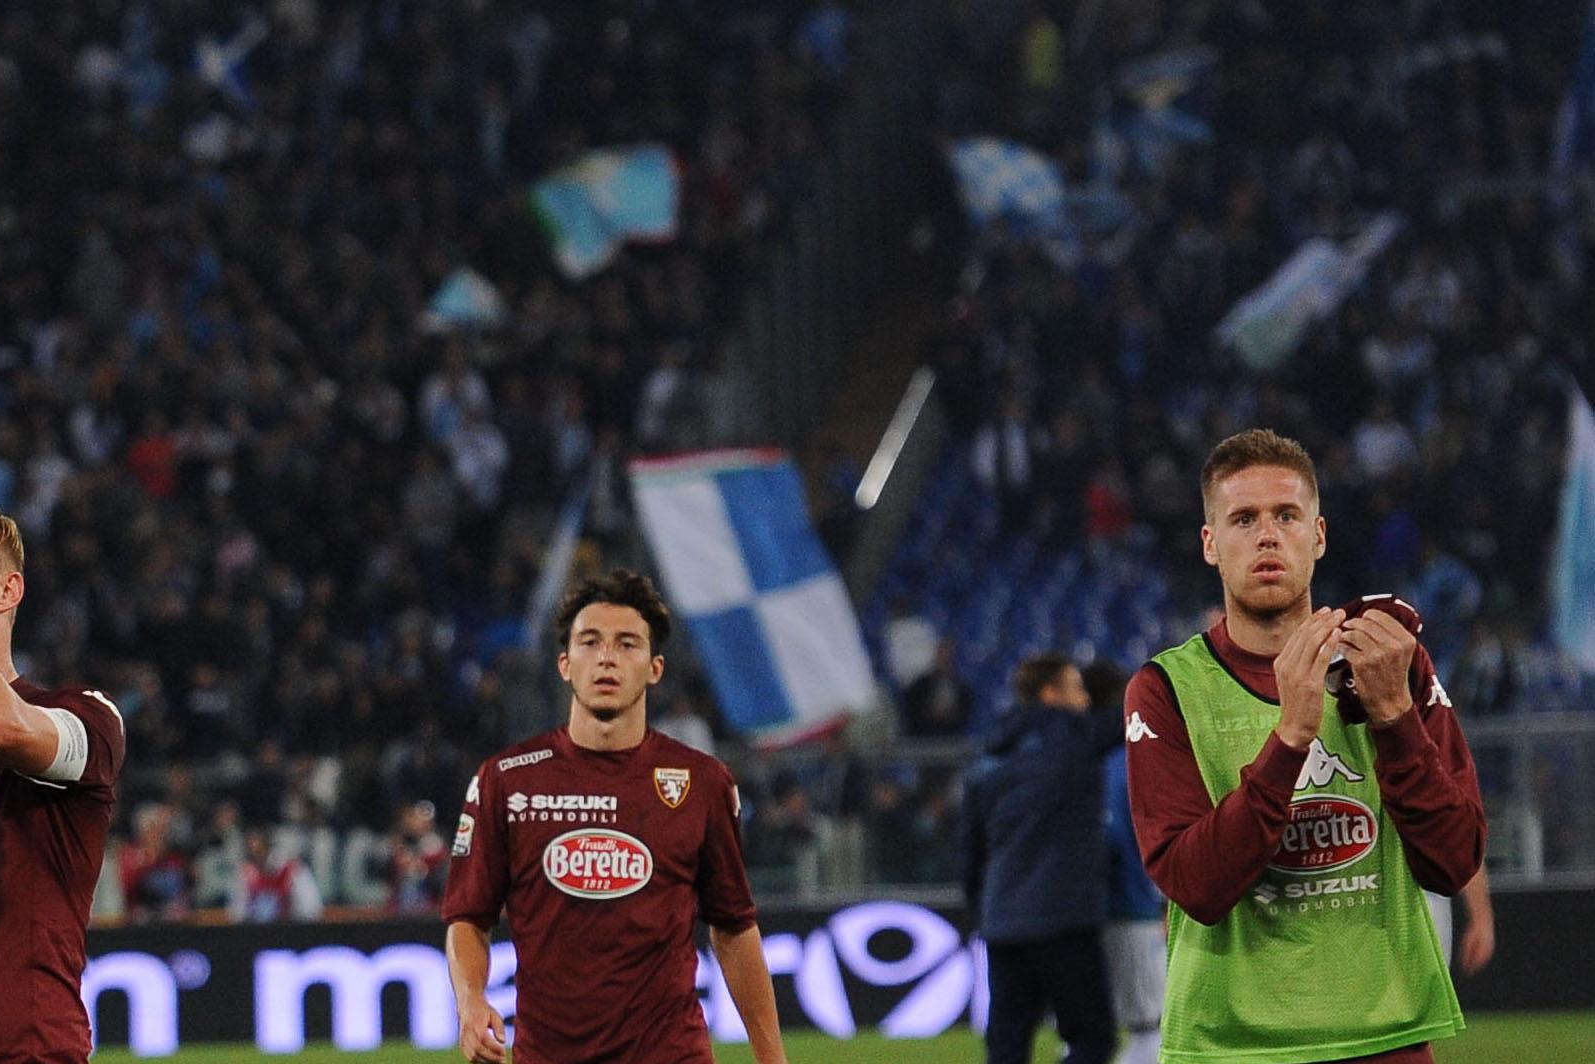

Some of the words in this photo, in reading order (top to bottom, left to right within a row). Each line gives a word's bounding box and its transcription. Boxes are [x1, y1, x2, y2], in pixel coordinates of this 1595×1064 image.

[531, 795, 617, 810] SUZUKI
[508, 812, 617, 823] AUTOMOBILI
[1289, 803, 1333, 820] Fratelli
[1274, 812, 1373, 854] eretta
[550, 845, 646, 880] Beretta
[1300, 851, 1335, 866] 1812
[1285, 873, 1380, 898] SUZUK
